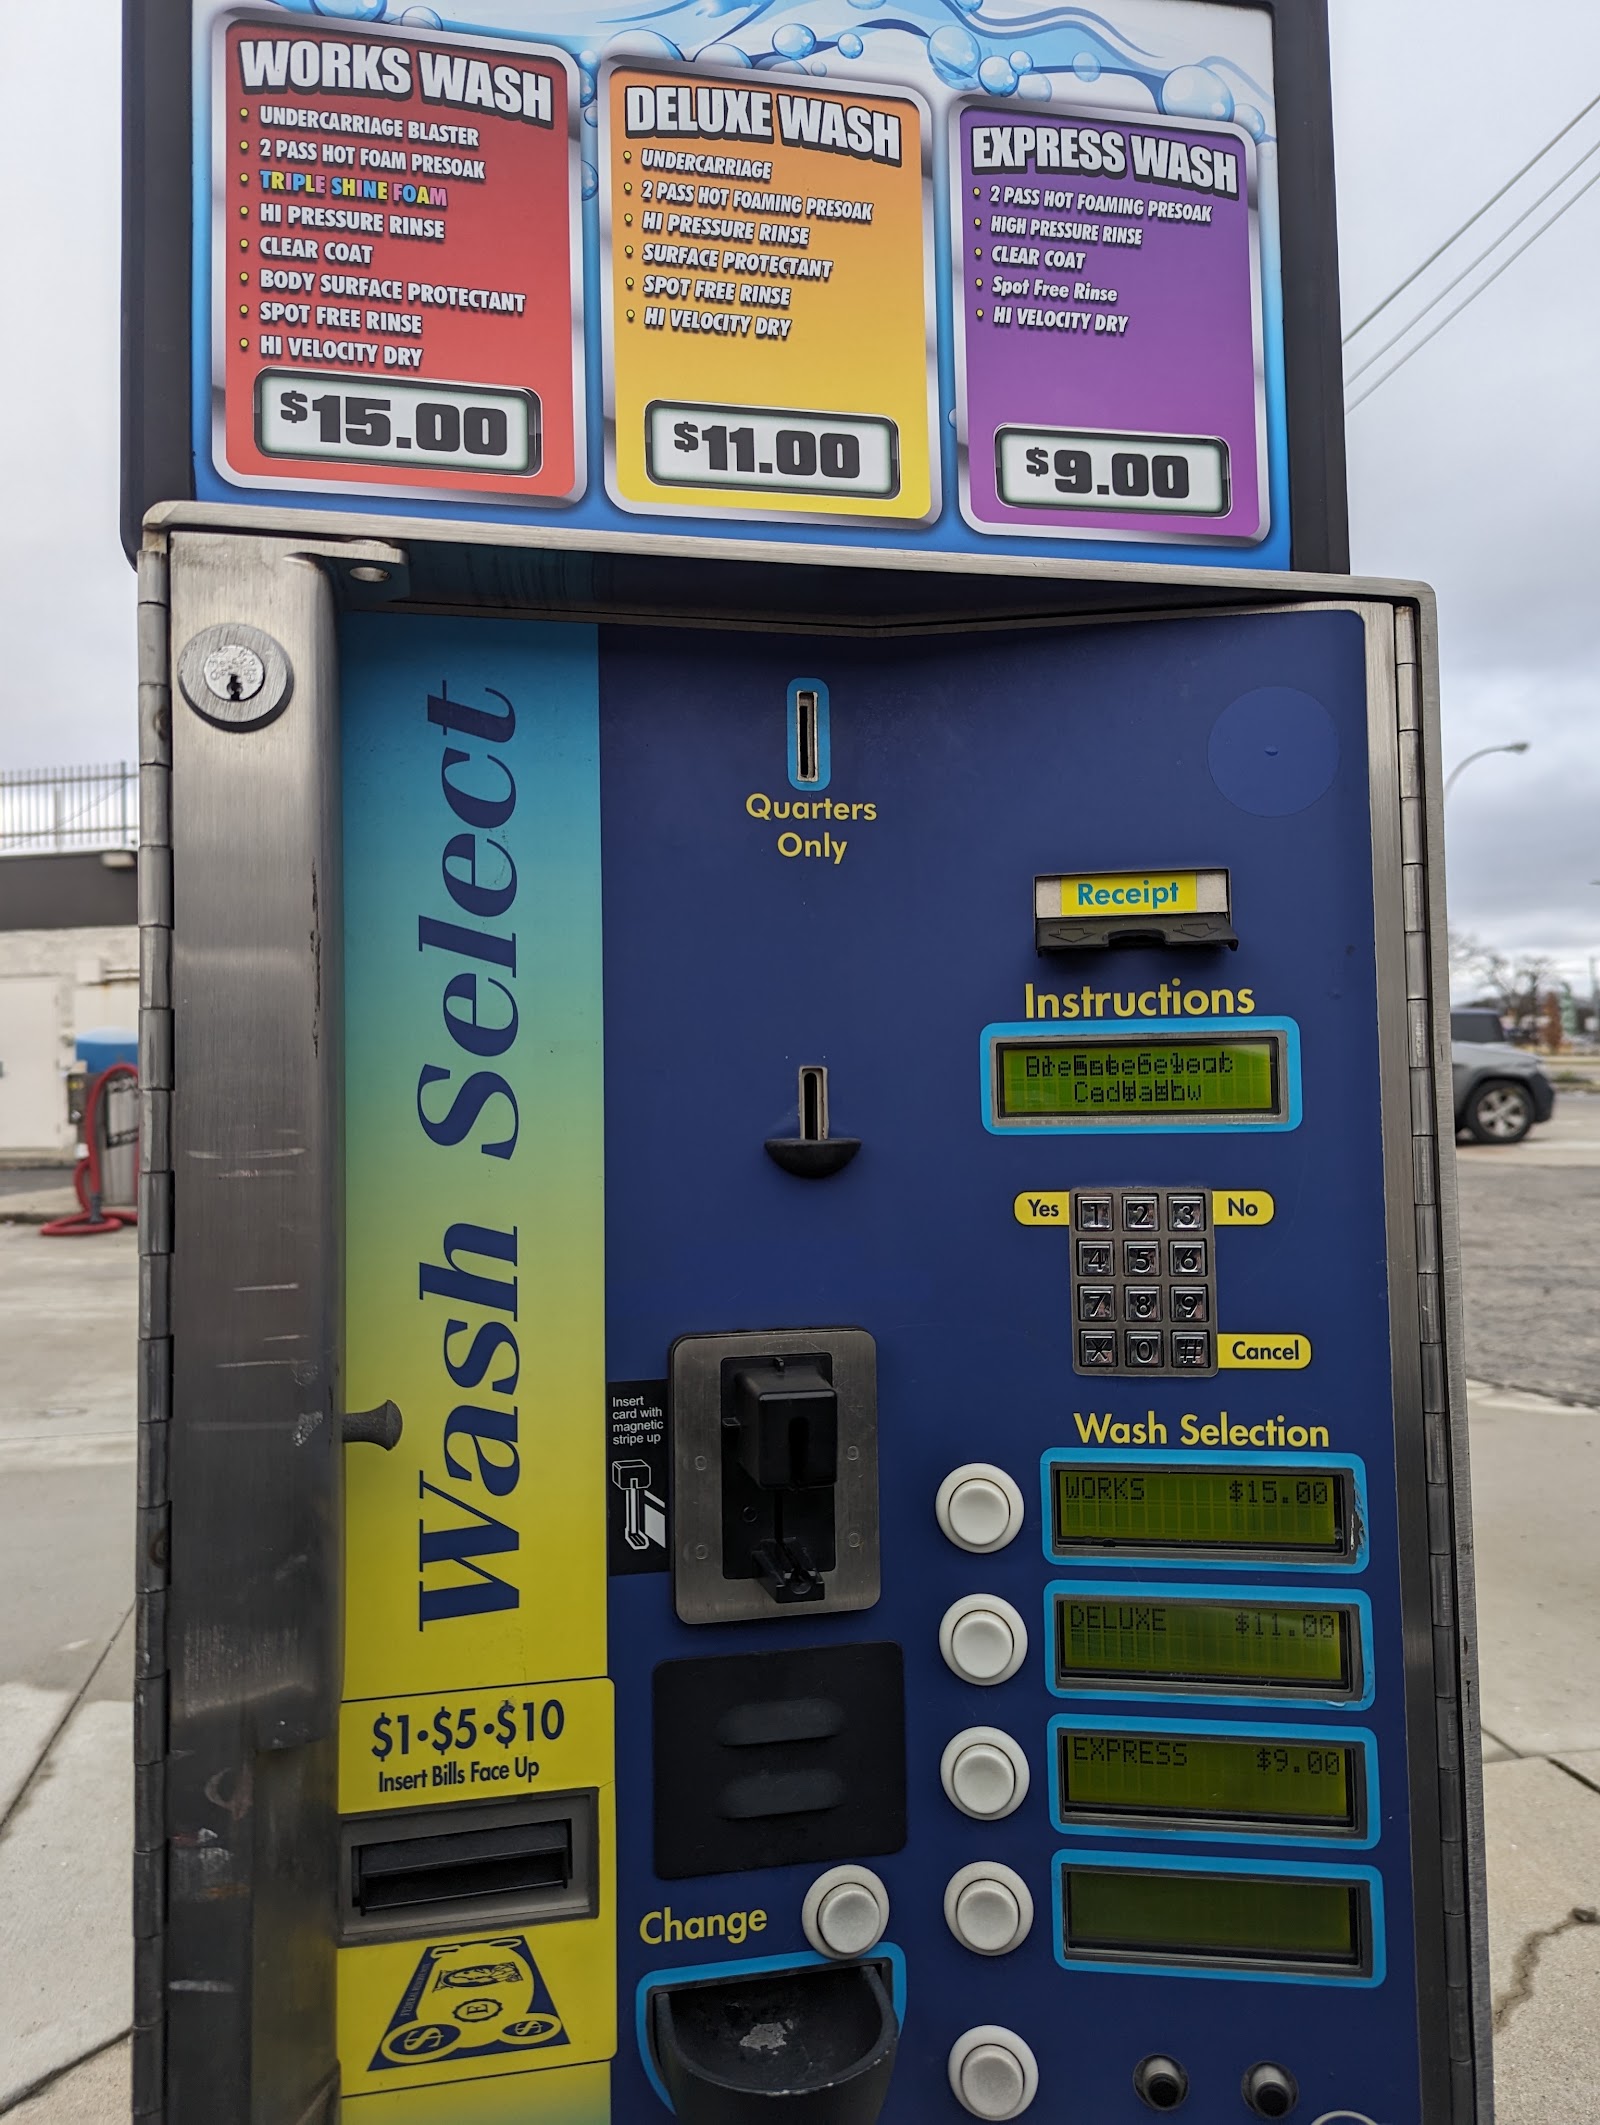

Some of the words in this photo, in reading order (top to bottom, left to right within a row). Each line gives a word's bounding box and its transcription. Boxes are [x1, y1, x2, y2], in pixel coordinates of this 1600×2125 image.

[239, 40, 412, 96] WORKS
[418, 51, 553, 124] WASH
[260, 105, 403, 138] UNDERCARRIAGE
[408, 121, 479, 147] BLASTER
[626, 86, 773, 138] DELUXE
[777, 95, 901, 161] WASH
[260, 139, 271, 157] 2
[276, 141, 318, 161] PASS
[322, 145, 355, 165] HOT
[360, 148, 407, 171] FOAM
[411, 154, 485, 180] PRESOAK
[641, 149, 772, 179] UNDERCARRIAGE
[972, 127, 1127, 174] EXPRESS
[1130, 135, 1238, 194] WASH
[260, 170, 326, 194] TRIPLE
[331, 177, 388, 200] SHINE
[393, 182, 447, 206] FOAM
[641, 181, 653, 198] 2
[656, 182, 694, 201] PASS
[698, 186, 730, 206] HOT
[733, 190, 803, 214] FOAMING
[806, 198, 874, 221] PRESOAK
[990, 186, 1001, 202] 2
[1004, 187, 1040, 206] PASS
[1044, 191, 1074, 209] HOT
[1077, 194, 1144, 216] FOAMING
[1148, 200, 1212, 223] PRESOAK
[260, 203, 281, 223] HI
[288, 206, 384, 233] PRESSURE
[389, 216, 445, 239] RINSE
[642, 212, 662, 230] HI
[667, 214, 754, 239] PRESSURE
[759, 223, 810, 245] RINSE
[990, 216, 1027, 235] HIGH
[1030, 218, 1099, 242] PRESSURE
[1102, 226, 1143, 246] RINSE
[259, 236, 318, 259] CLEAR
[325, 242, 373, 264] COAT
[642, 244, 719, 268] SURFACE
[722, 251, 833, 279] PROTECTANT
[991, 245, 1039, 266] CLEAR
[1044, 250, 1086, 270] COAT
[260, 269, 315, 292] BODY
[320, 274, 402, 300] SURFACE
[408, 282, 525, 313] PROTECTANT
[643, 275, 691, 296] SPOT
[695, 280, 736, 301] FREE
[739, 285, 791, 306] RINSE
[992, 276, 1030, 296] Spot
[1033, 279, 1069, 299] Free
[1073, 282, 1118, 303] Rinse
[260, 302, 311, 323] SPOT
[316, 306, 361, 328] FREE
[366, 311, 422, 334] RINSE
[644, 307, 665, 325] HI
[670, 309, 752, 333] VELOCITY
[755, 318, 792, 337] DRY
[993, 306, 1012, 324] HI
[1016, 308, 1092, 330] VELOCITY
[1094, 315, 1129, 333] DRY
[260, 335, 282, 355] HI
[288, 337, 378, 363] VELOCITY
[384, 346, 423, 367] DRY
[280, 390, 508, 456] $15.00
[673, 421, 860, 480] $11.00
[1025, 446, 1190, 499] $9.00
[745, 793, 878, 821] Quarters
[777, 832, 848, 865] Only
[1077, 880, 1179, 909] Receipt
[416, 678, 520, 1162] Select
[1025, 978, 1255, 1019] Instructions
[1027, 1199, 1059, 1217] Yes
[1090, 1204, 1100, 1225] 1
[1133, 1205, 1149, 1226] 2
[1178, 1205, 1195, 1226] 3
[1228, 1198, 1258, 1217] No
[1087, 1250, 1105, 1272] 4
[1135, 1250, 1151, 1272] 5
[1181, 1250, 1197, 1272] 6
[1089, 1296, 1107, 1317] 7
[1135, 1296, 1152, 1318] 8
[1181, 1296, 1198, 1318] 9
[1232, 1340, 1300, 1361] Cancel
[612, 1396, 644, 1408] Insert
[612, 1408, 637, 1420] card
[640, 1407, 662, 1418] with
[418, 1225, 520, 1632] Wash
[612, 1419, 664, 1434] magnetic
[612, 1433, 644, 1446] stripe
[647, 1433, 661, 1444] up
[1073, 1410, 1168, 1445] Wash
[1180, 1411, 1329, 1448] Selection
[1065, 1476, 1145, 1501] WORKS
[1229, 1480, 1328, 1504] $15.00
[1070, 1605, 1166, 1631] DELUXE
[1235, 1612, 1335, 1638] $11.00
[1073, 1737, 1188, 1766] EXPRESS
[1257, 1748, 1340, 1776] $9.00
[378, 1770, 427, 1793] Insert
[432, 1761, 465, 1787] Bills
[470, 1761, 510, 1782] Face
[514, 1756, 540, 1783] Up
[639, 1906, 767, 1944] Change
